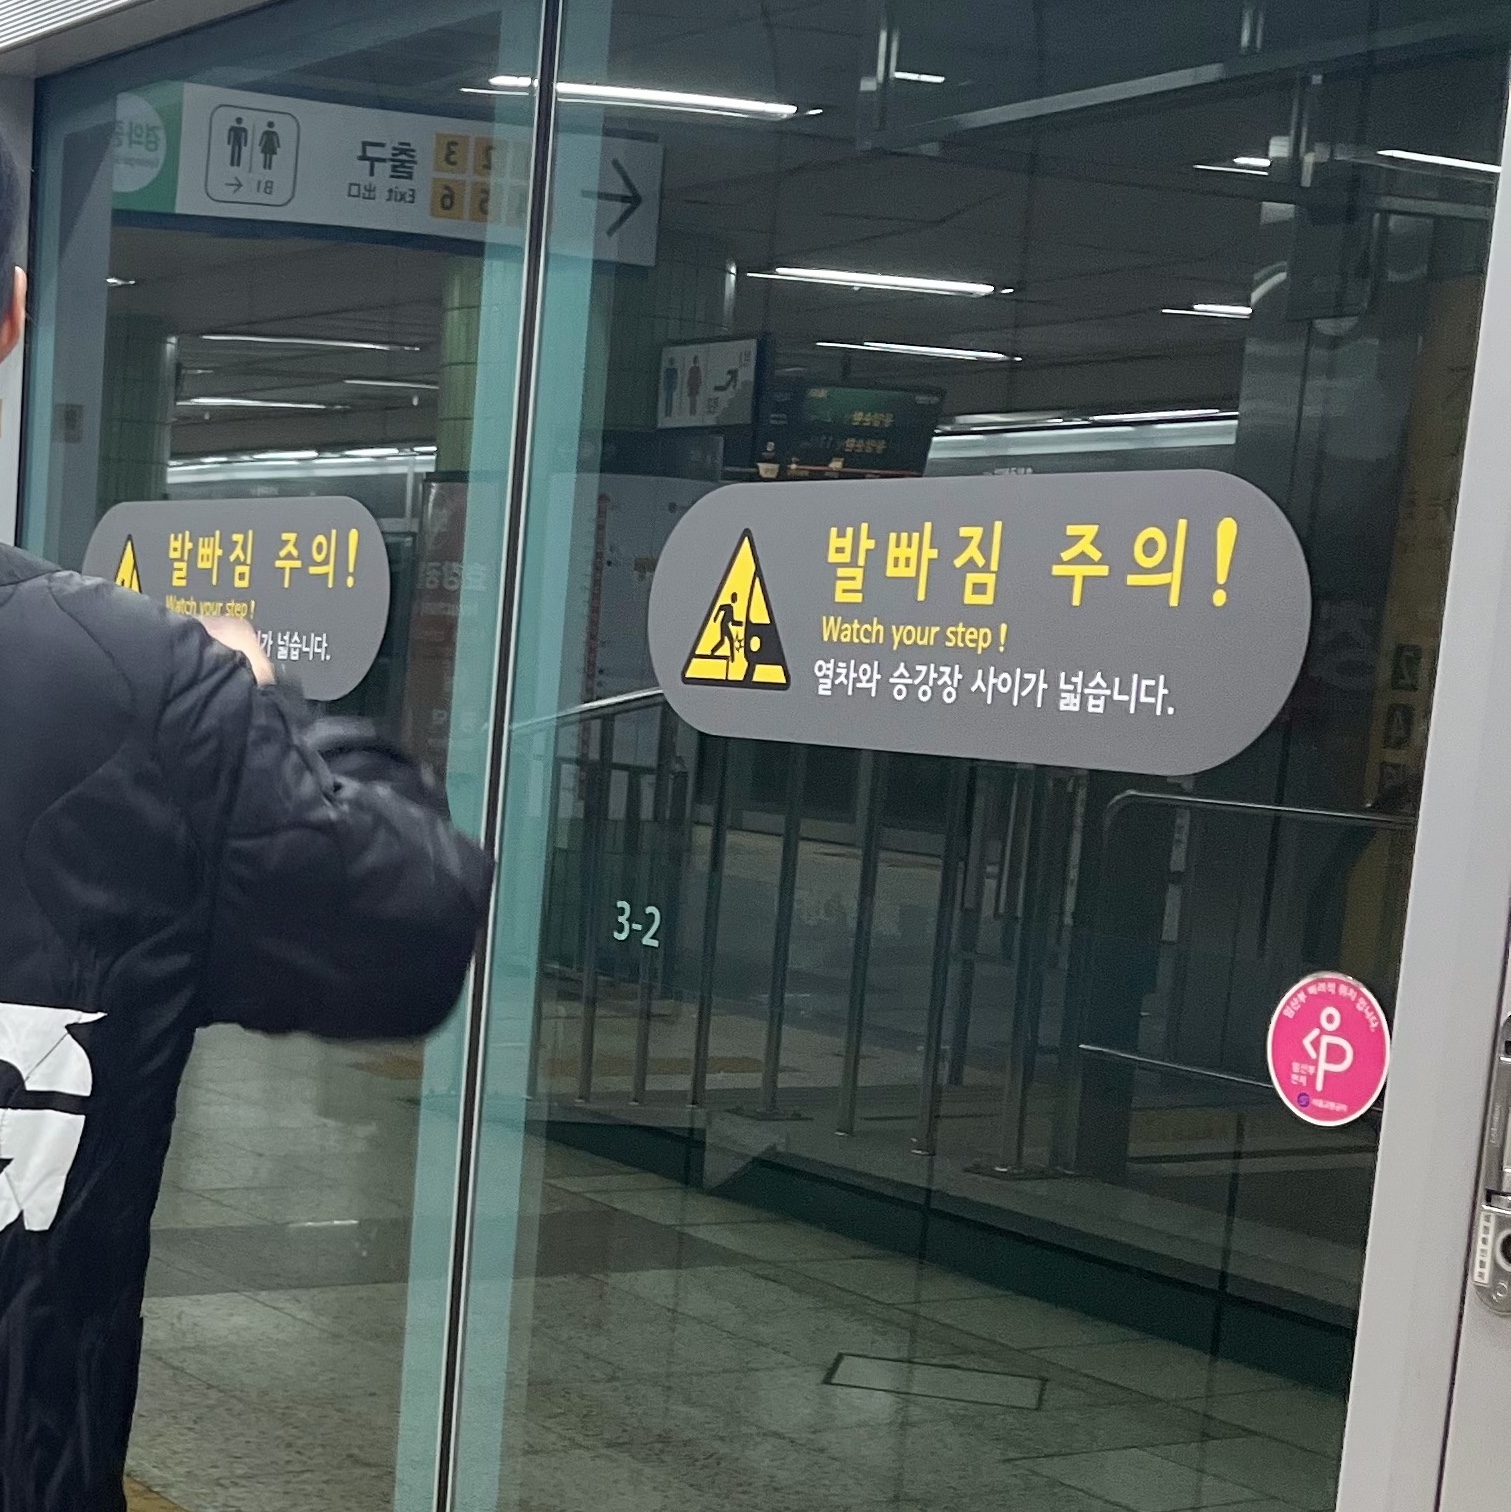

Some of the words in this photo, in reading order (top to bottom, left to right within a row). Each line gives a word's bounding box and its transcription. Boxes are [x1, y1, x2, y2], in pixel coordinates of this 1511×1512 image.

[168, 529, 254, 588] 발빠짐
[274, 528, 359, 589] 주의!
[827, 520, 1003, 605] 발빠짐
[1051, 516, 1238, 607] 주의!
[165, 594, 197, 616] Watch
[276, 630, 331, 661] 넓습니다.
[821, 616, 885, 645] Watch
[890, 623, 940, 650] your
[814, 659, 882, 698] 열차와
[888, 662, 963, 704] 승강장
[970, 666, 1049, 708] 사이가
[1058, 670, 1176, 716] 넓습니다.
[613, 900, 661, 948] 3-2
